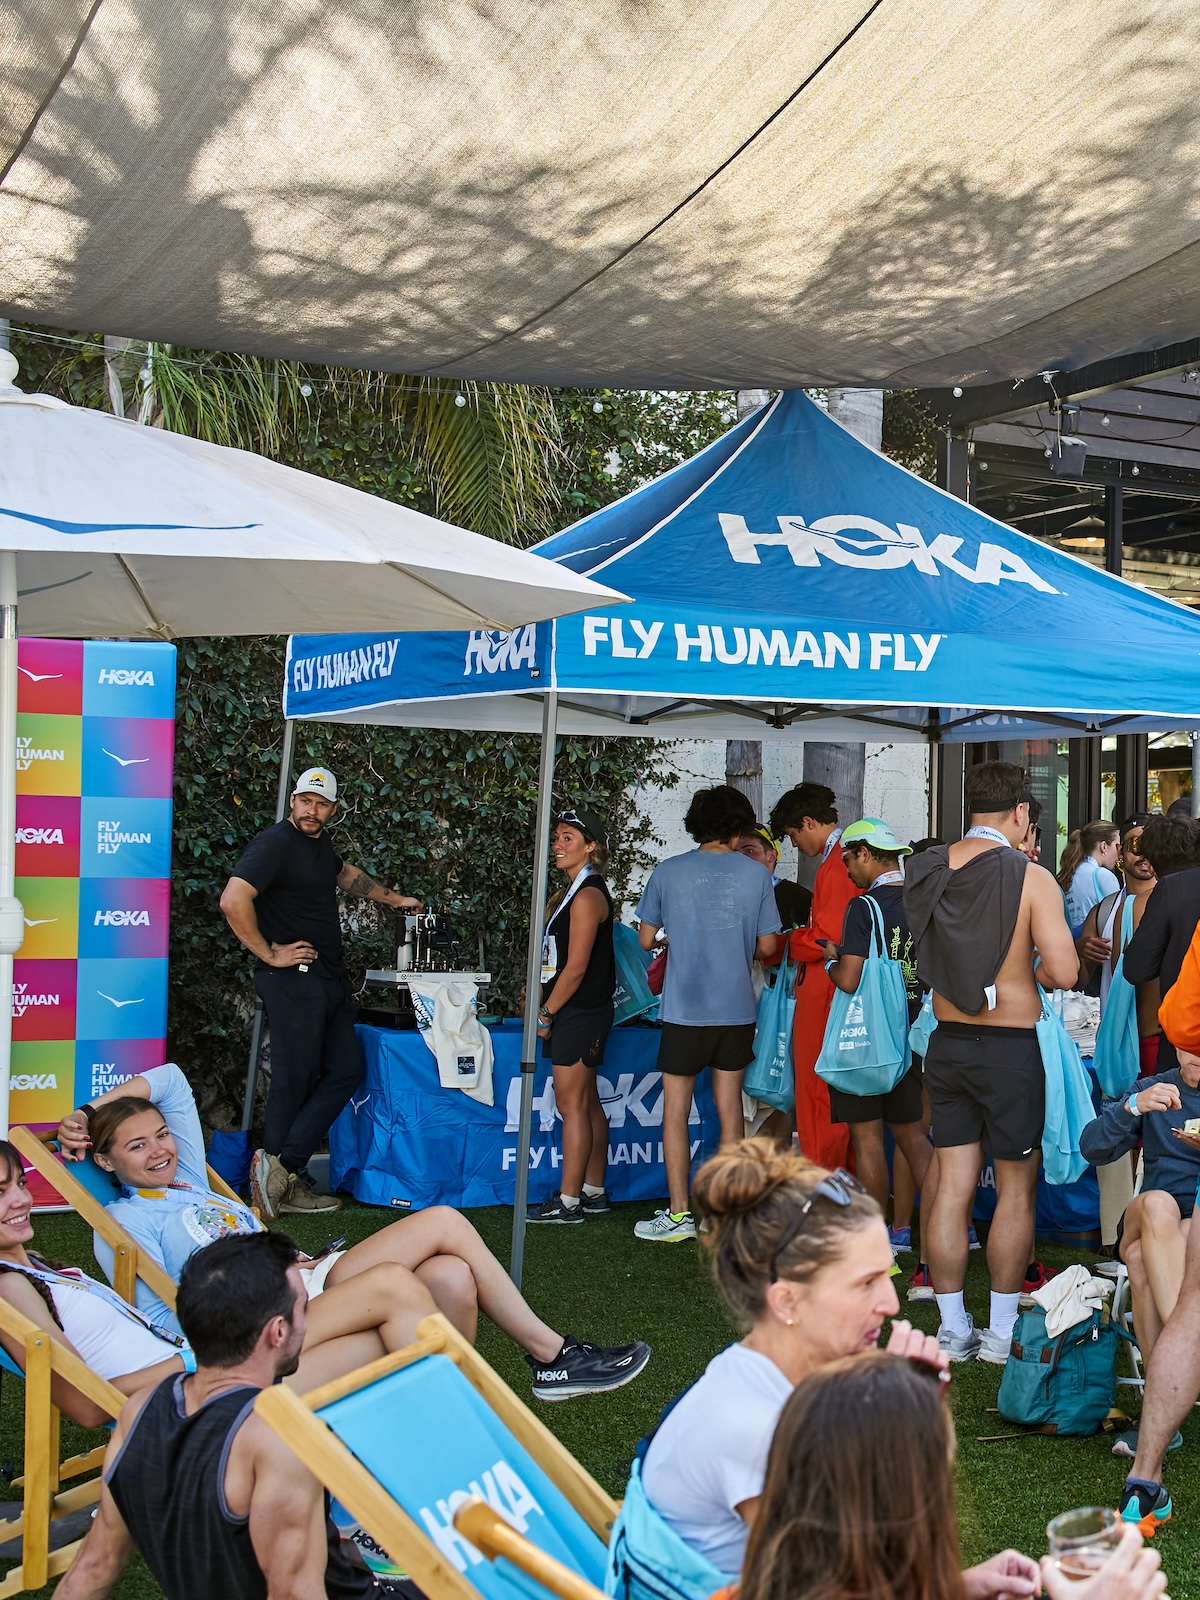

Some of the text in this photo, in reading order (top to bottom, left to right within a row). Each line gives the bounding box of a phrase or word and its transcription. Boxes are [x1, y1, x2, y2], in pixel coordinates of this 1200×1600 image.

[718, 513, 1061, 595] HOKA
[463, 622, 537, 676] HOKA
[583, 616, 942, 671] FLY HUMAN FLY
[293, 638, 400, 692] FLY HUMAN FLY
[98, 669, 154, 686] HOKA
[17, 737, 32, 748] LY
[16, 760, 32, 770] LY
[98, 821, 120, 831] FLY
[98, 833, 151, 843] HUMAN
[97, 843, 120, 854] FLY
[94, 911, 150, 926] HOKA
[12, 984, 28, 994] LY
[11, 1006, 27, 1016] LY
[840, 1026, 868, 1038] HOKA
[92, 1064, 115, 1074] FLY
[92, 1074, 140, 1086] HUMA
[502, 1146, 546, 1170] FY
[537, 1370, 568, 1381] HOKA
